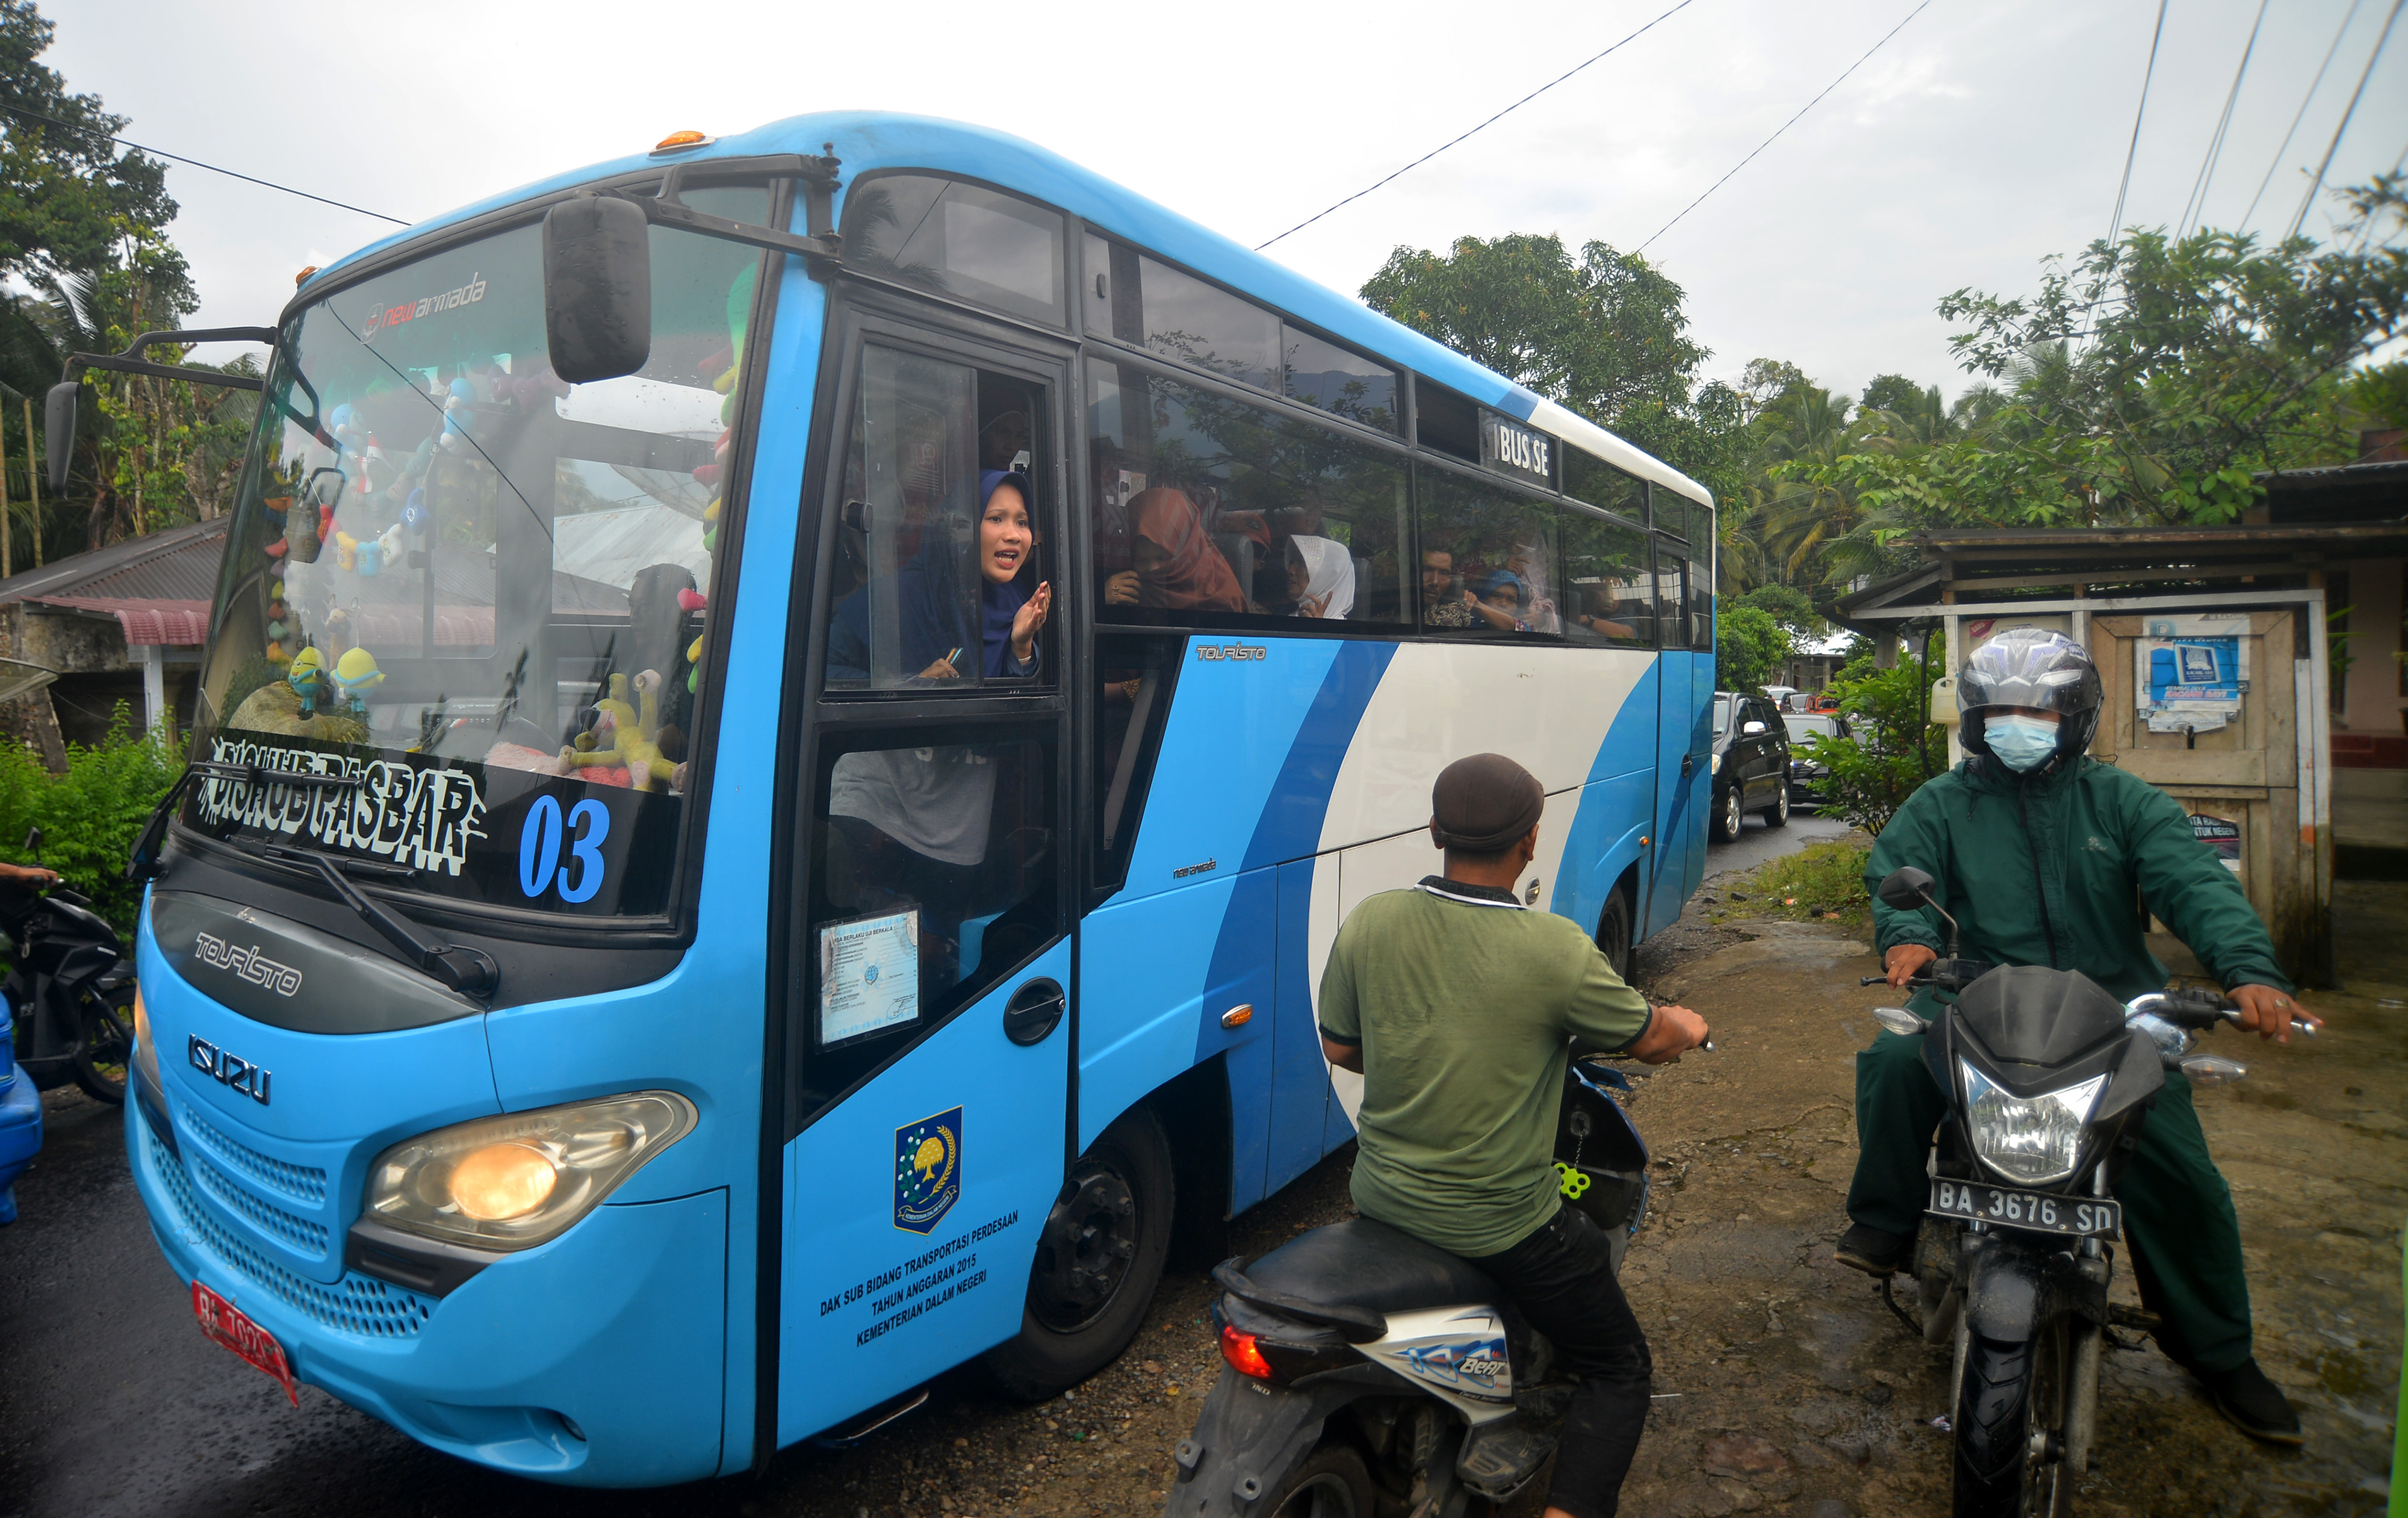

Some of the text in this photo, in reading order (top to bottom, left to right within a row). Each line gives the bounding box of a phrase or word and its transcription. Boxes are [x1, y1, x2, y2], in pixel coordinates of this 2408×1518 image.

[1500, 425, 1530, 469] BUS
[1970, 621, 1985, 633] BARU
[520, 795, 610, 903] 03
[843, 932, 865, 941] BERLAKU
[188, 1032, 272, 1106] ISUZU
[1940, 1182, 1972, 1213] BA
[1988, 1191, 2056, 1225] 3676
[820, 1209, 1019, 1317] DAK SUB BIDANG TRANSPORTASI PERDESAAN
[872, 1253, 976, 1316] TAHUN ANGGARAN 2015
[856, 1268, 987, 1348] KEMENTERIAN DALAM NEGERI
